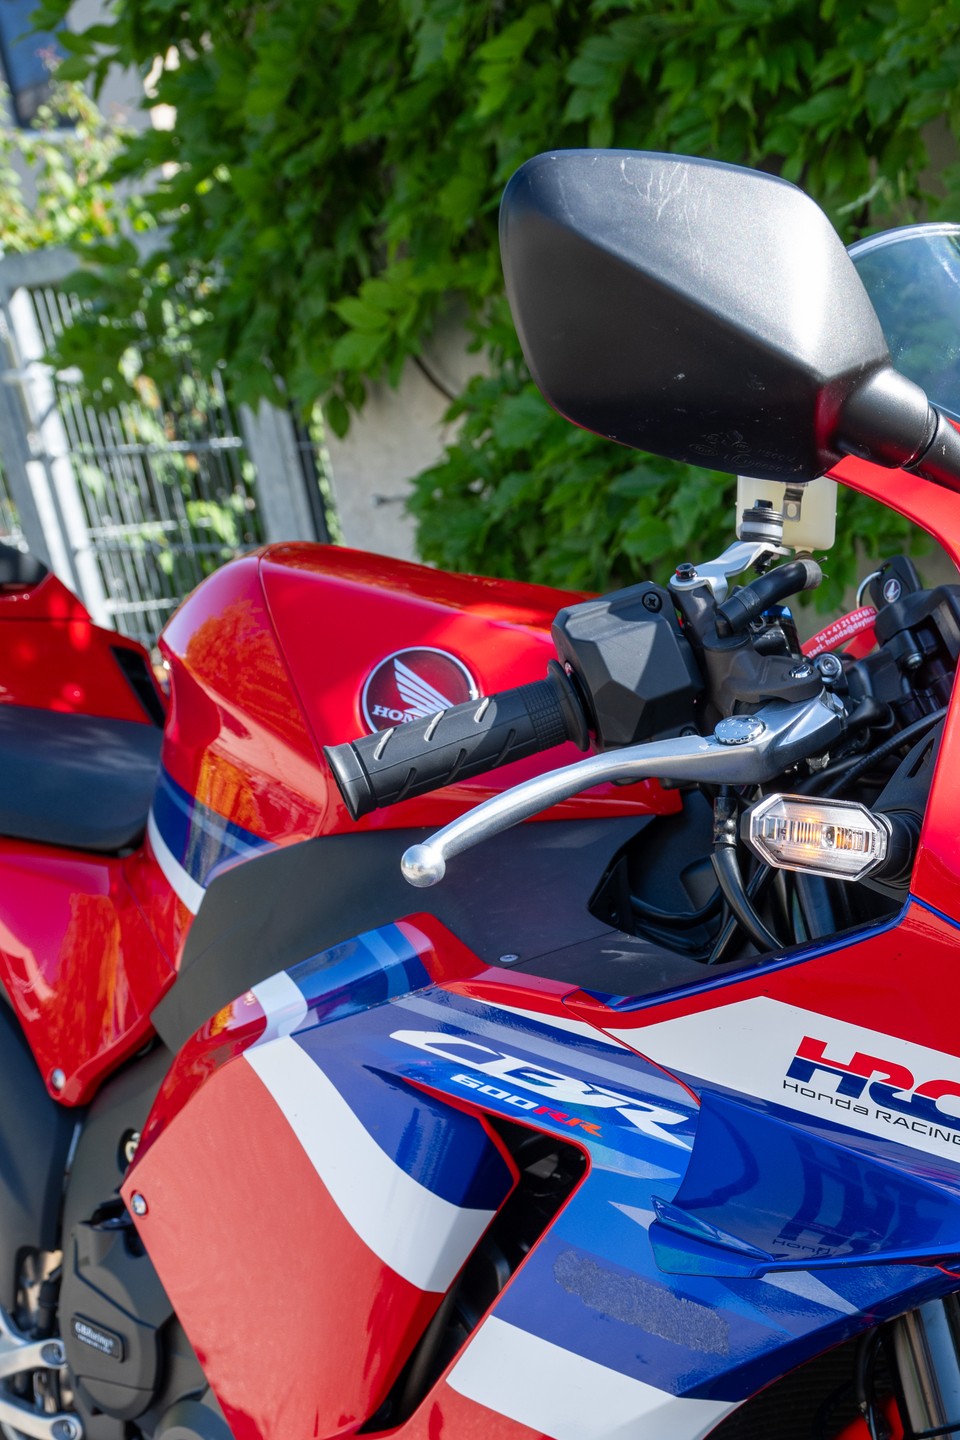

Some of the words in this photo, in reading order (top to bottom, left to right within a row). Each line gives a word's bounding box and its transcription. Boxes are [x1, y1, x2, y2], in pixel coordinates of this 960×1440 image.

[371, 704, 419, 723] HON
[389, 1030, 694, 1150] CBR
[449, 1073, 605, 1138] 600RR
[783, 1080, 869, 1116] Honda
